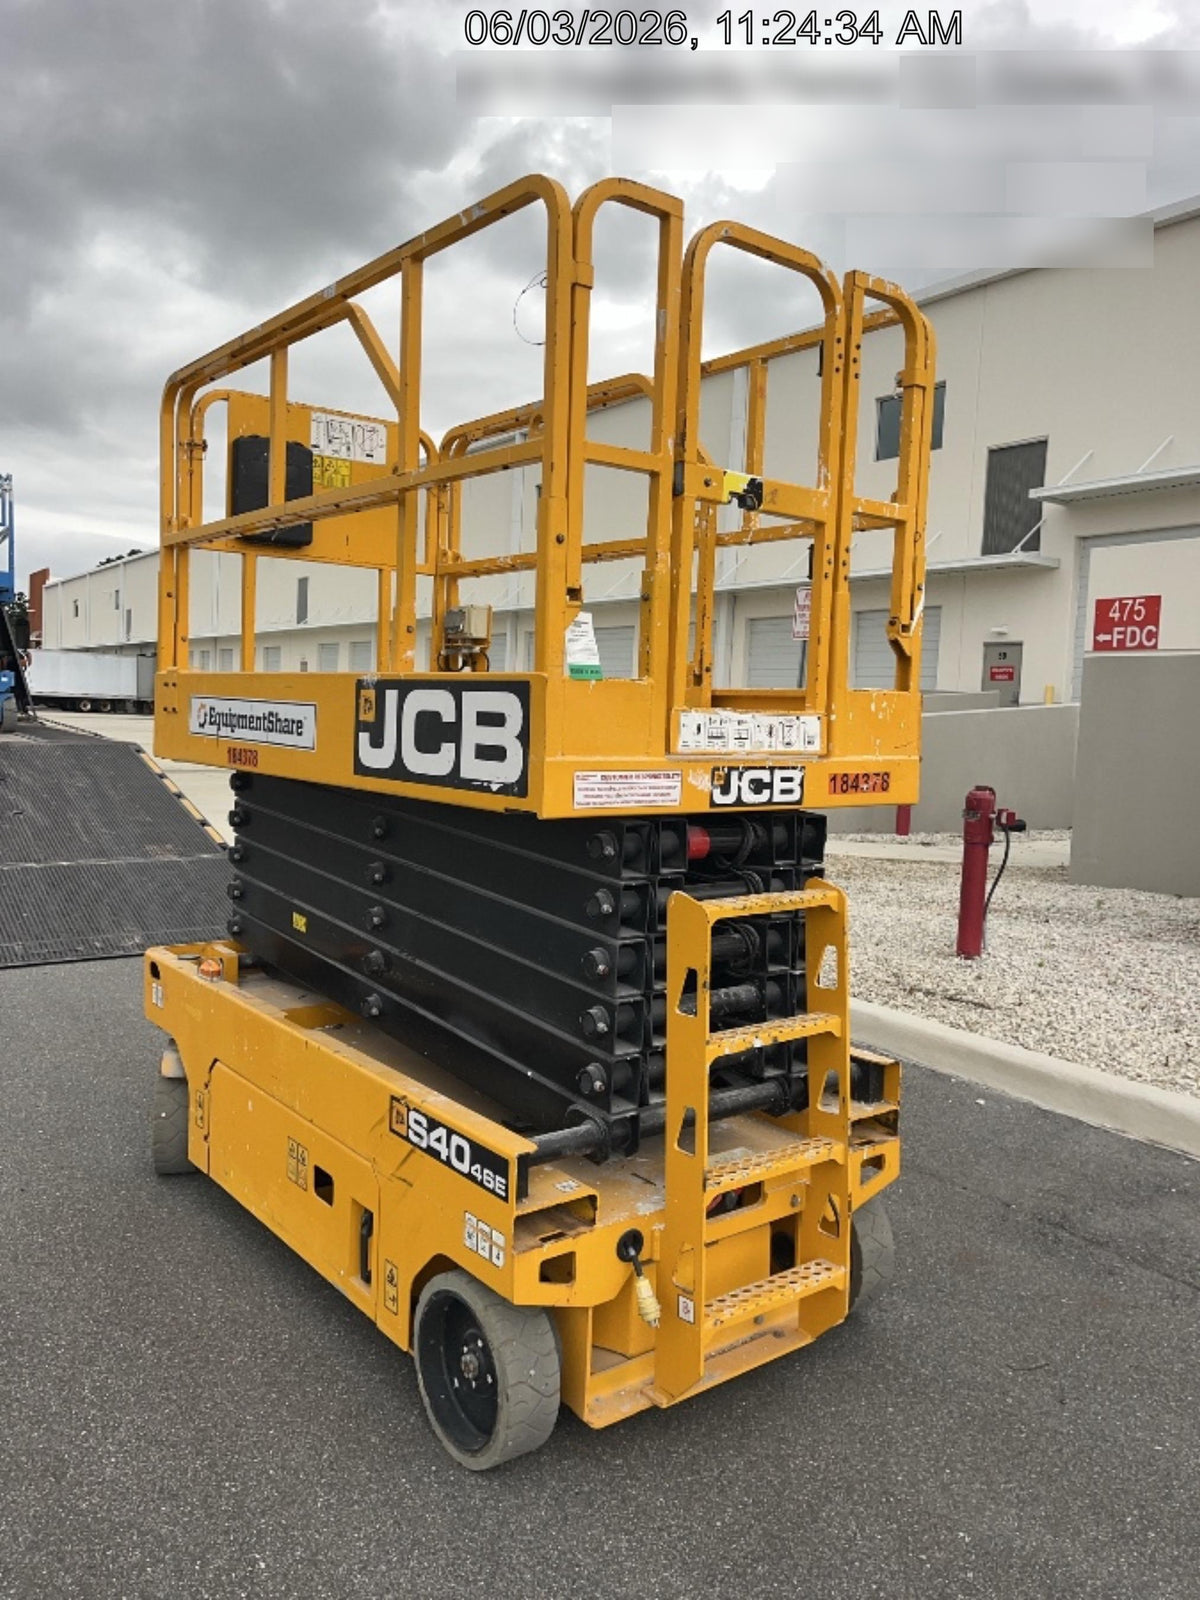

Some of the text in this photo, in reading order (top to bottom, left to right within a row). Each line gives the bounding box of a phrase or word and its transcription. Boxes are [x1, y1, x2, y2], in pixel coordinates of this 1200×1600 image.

[1109, 598, 1146, 621] 475
[1112, 625, 1157, 648] FDC
[208, 706, 304, 736] EquipmentShare
[358, 689, 524, 783] JCB
[712, 768, 802, 805] JCB
